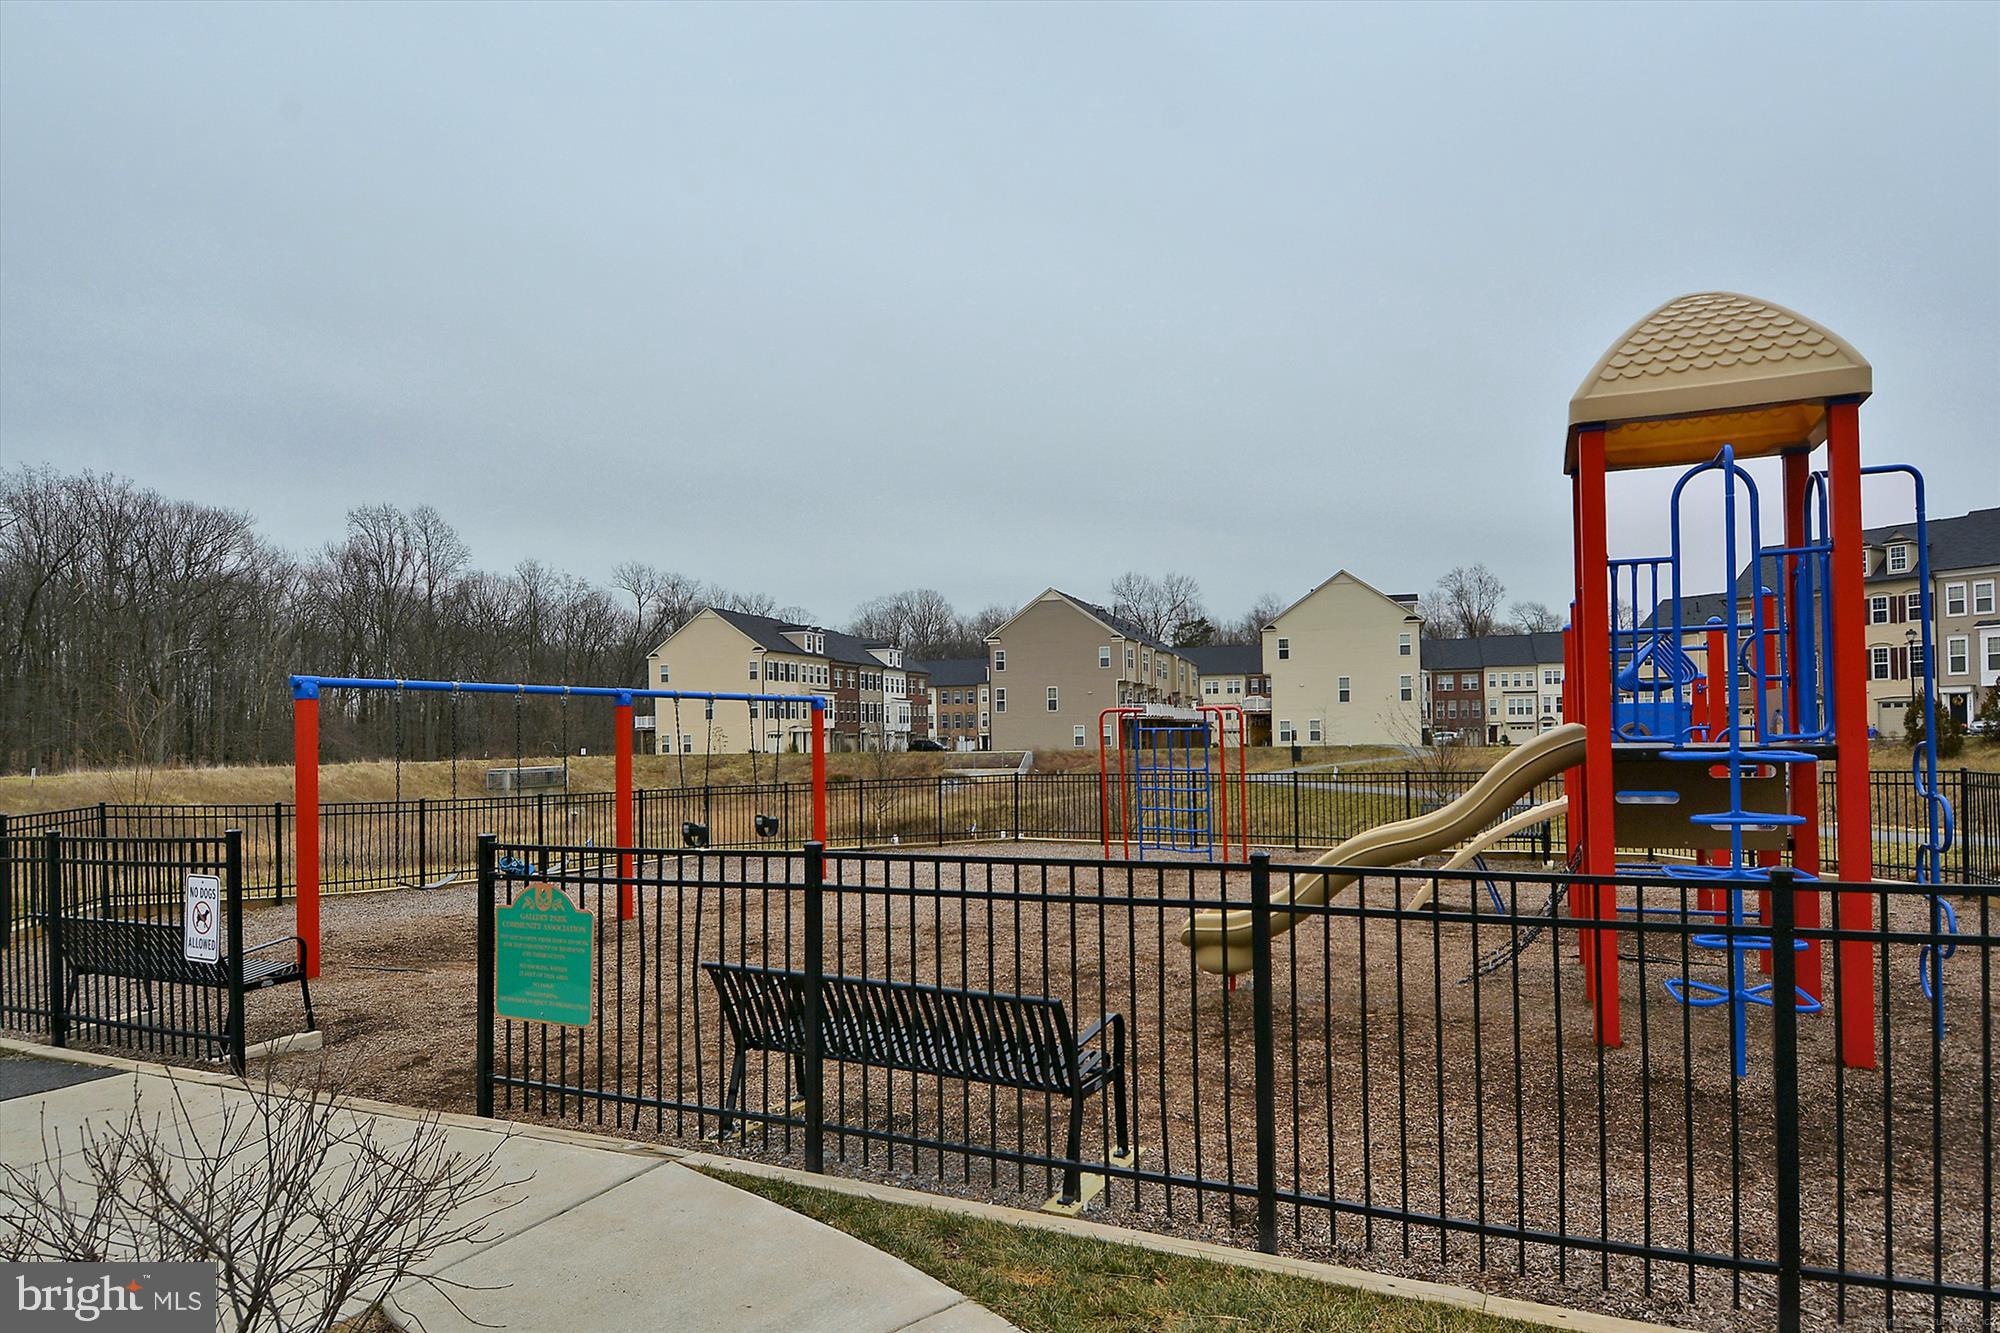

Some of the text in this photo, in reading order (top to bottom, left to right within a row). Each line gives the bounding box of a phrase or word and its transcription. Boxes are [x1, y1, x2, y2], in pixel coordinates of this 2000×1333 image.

[190, 886, 216, 900] NO DOGS
[502, 921, 586, 933] COMMUNITY ASSOCIATION
[188, 937, 215, 951] ALLOWED
